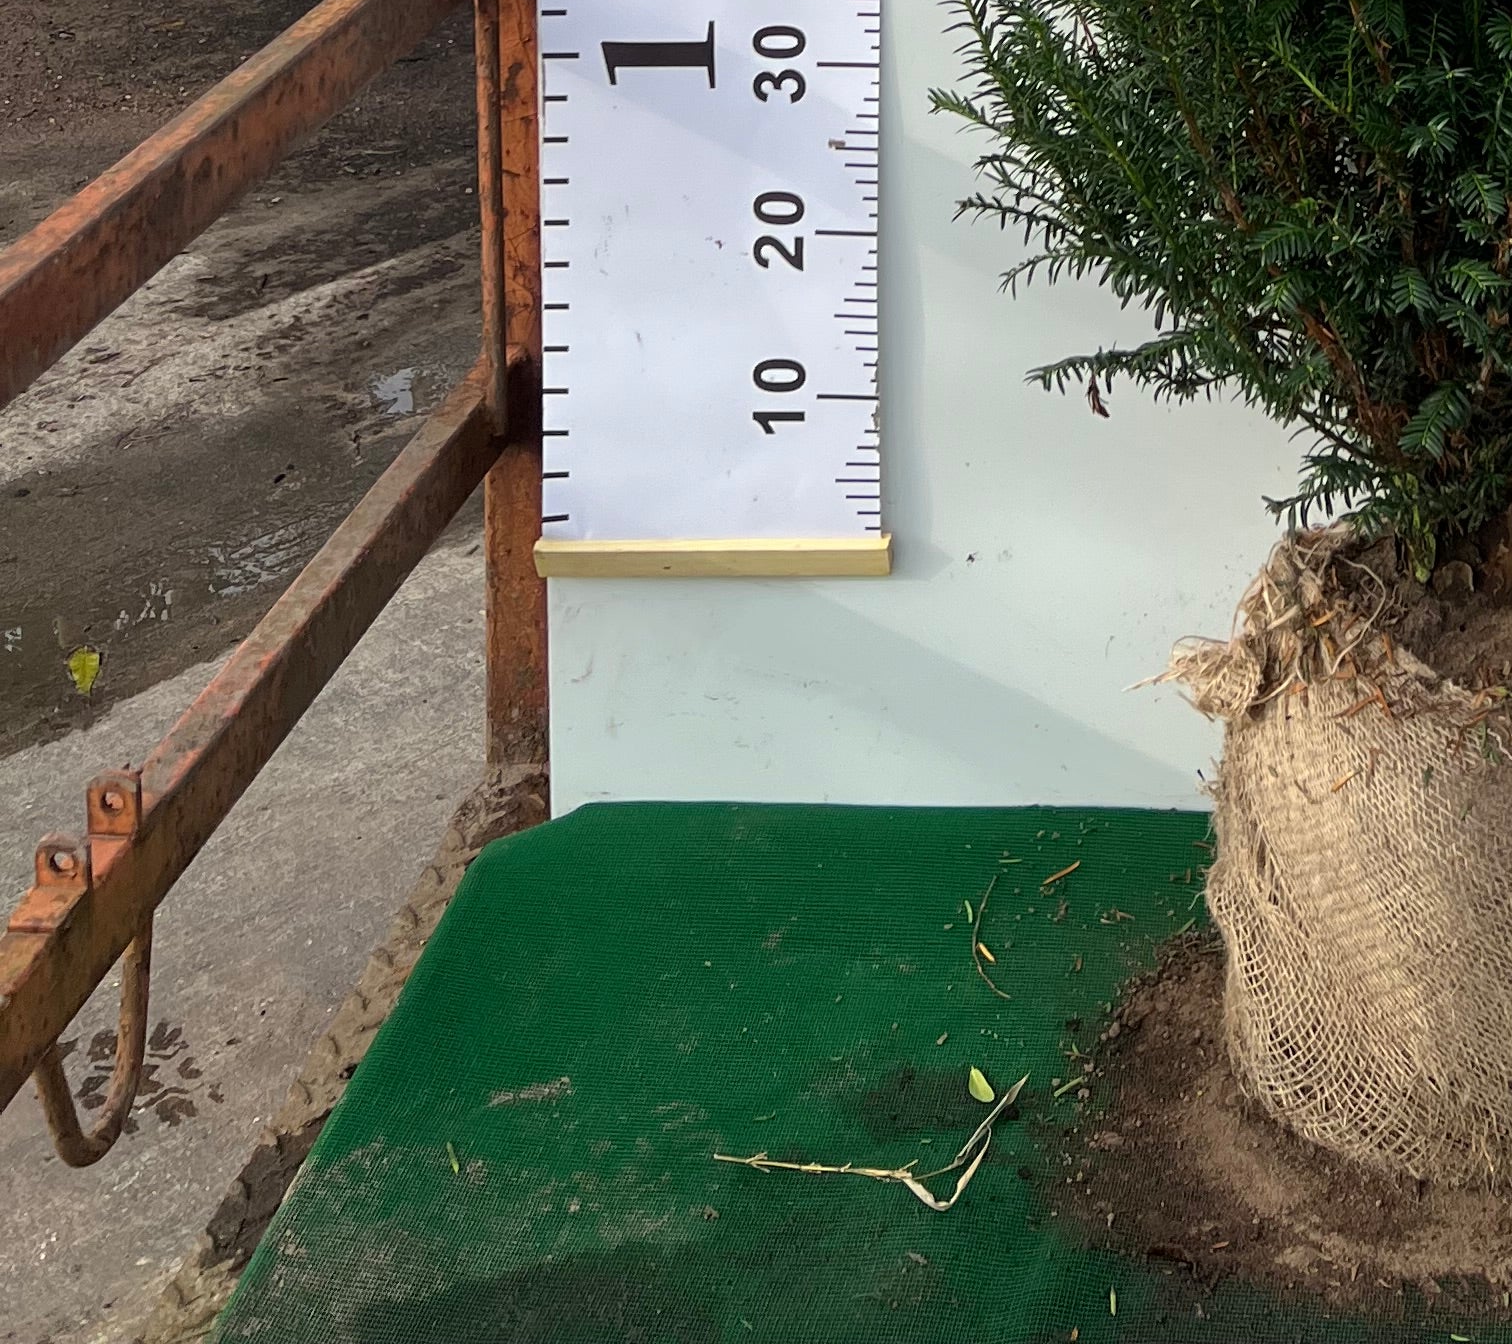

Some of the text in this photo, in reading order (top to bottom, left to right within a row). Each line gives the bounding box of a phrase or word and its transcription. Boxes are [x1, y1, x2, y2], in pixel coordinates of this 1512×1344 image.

[601, 21, 716, 90] 1
[753, 26, 807, 104] 30
[753, 192, 806, 272] 20
[753, 359, 807, 435] 10
